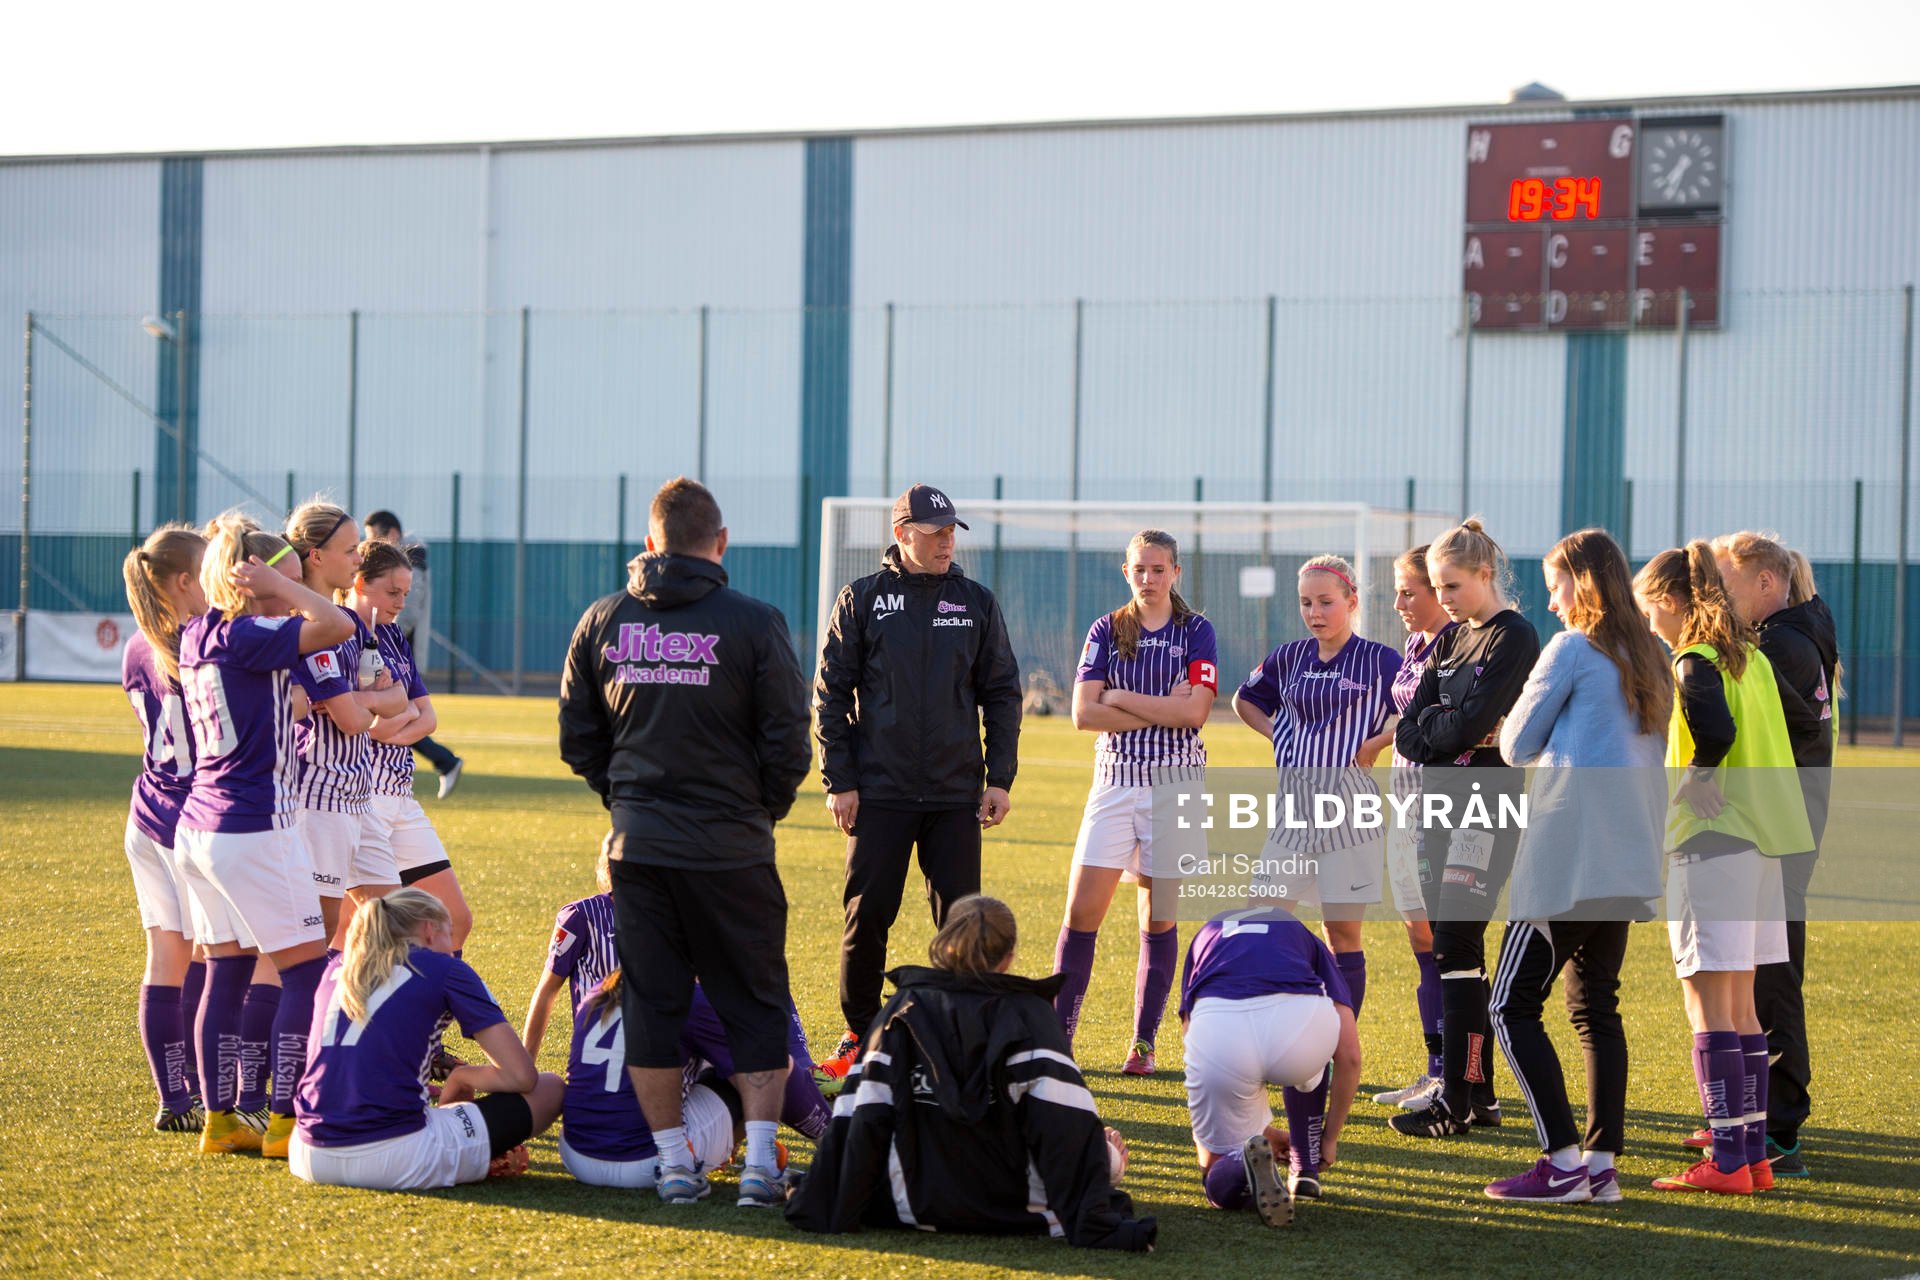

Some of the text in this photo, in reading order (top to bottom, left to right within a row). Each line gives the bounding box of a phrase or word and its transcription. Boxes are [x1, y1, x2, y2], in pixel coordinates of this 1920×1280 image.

[1468, 130, 1491, 162] H
[1609, 124, 1633, 158] G
[1508, 176, 1601, 222] 19:34
[1465, 237, 1484, 269] A
[1547, 234, 1569, 269] C
[1637, 232, 1655, 266] E
[1547, 290, 1568, 323] D
[873, 593, 905, 611] AM
[932, 617, 974, 628] stadium
[605, 623, 720, 665] Jitex
[615, 664, 710, 686] Akademi
[1303, 667, 1341, 680] stadium
[241, 1040, 268, 1092] Folksam
[581, 1005, 626, 1093] 4
[164, 1040, 186, 1093] Folksam
[217, 1033, 242, 1103] Folksam
[275, 1032, 308, 1101] Folksam
